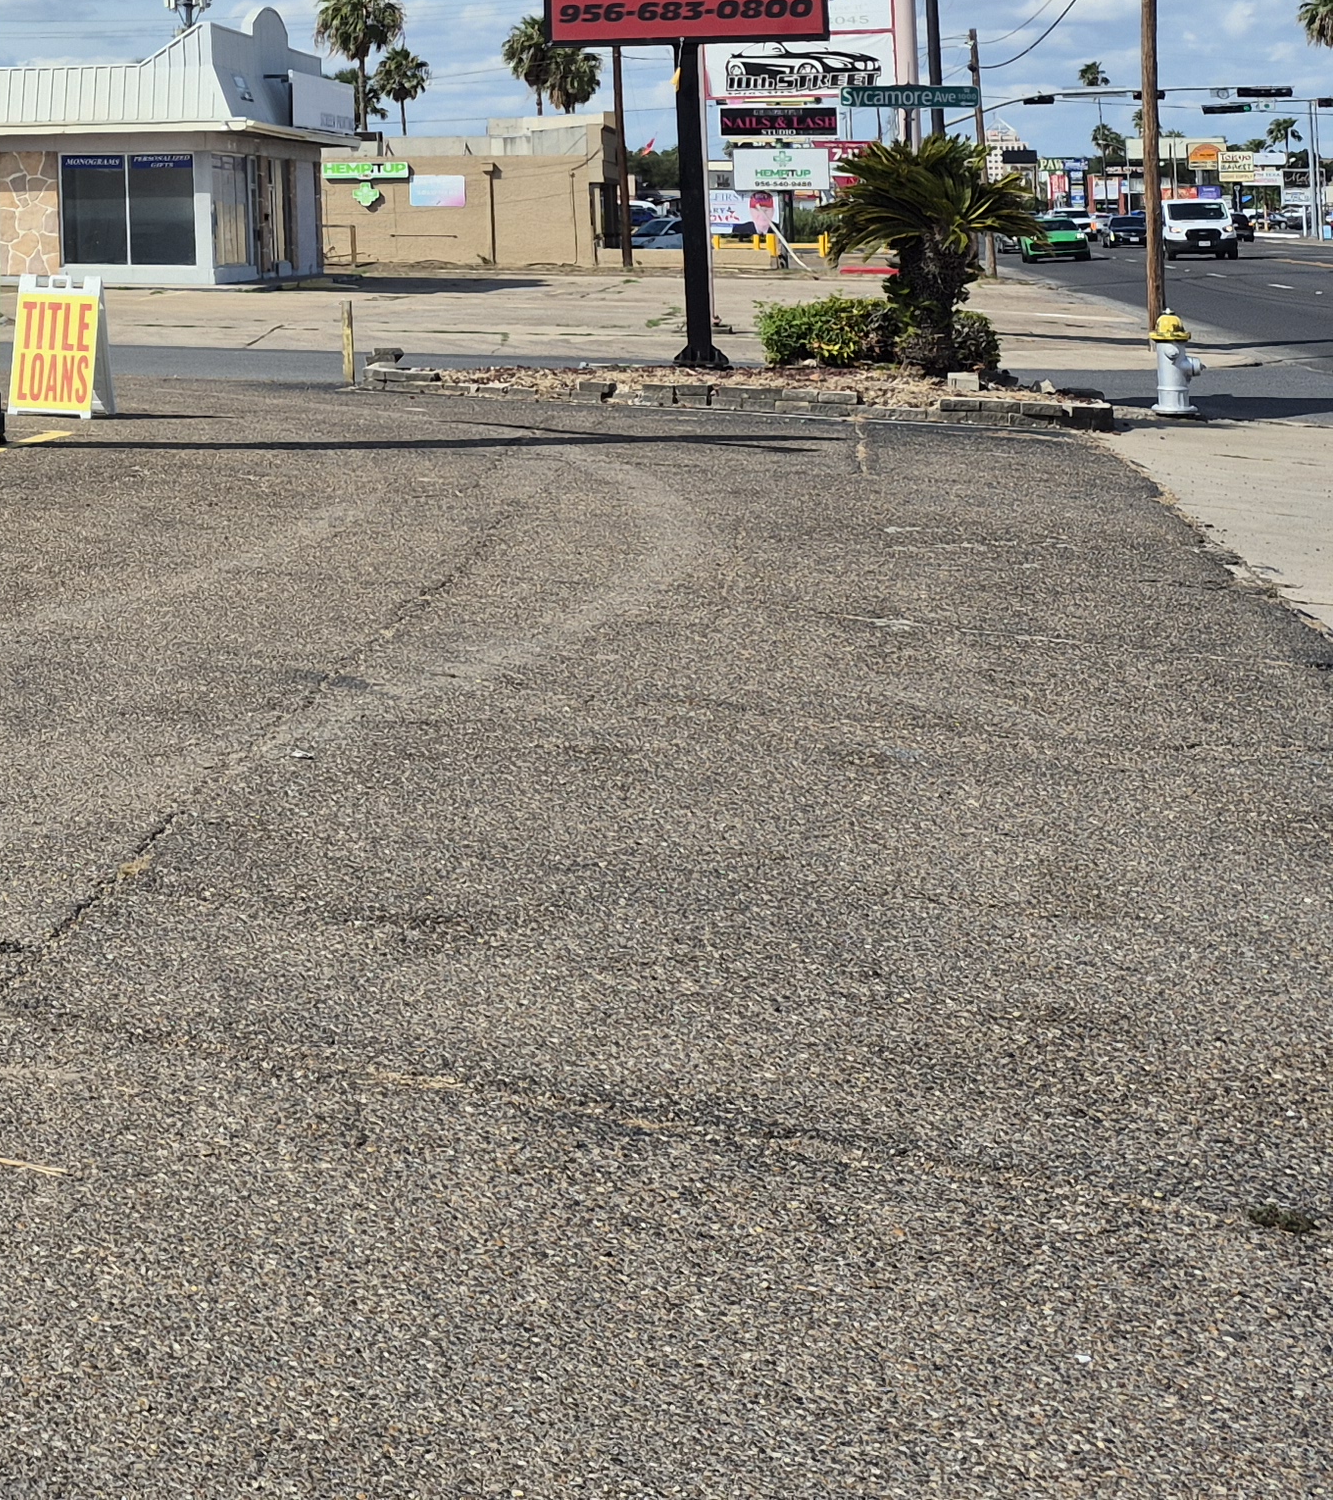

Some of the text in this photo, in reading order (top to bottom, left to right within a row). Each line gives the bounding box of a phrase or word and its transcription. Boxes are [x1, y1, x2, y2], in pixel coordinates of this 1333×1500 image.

[842, 88, 956, 107] Sycamore Ave
[723, 116, 837, 128] NAILS & LASH
[65, 155, 191, 166] MONOGRAMS PERSONALIZED
[23, 301, 92, 352] TITLE
[17, 353, 89, 404] LOANS
